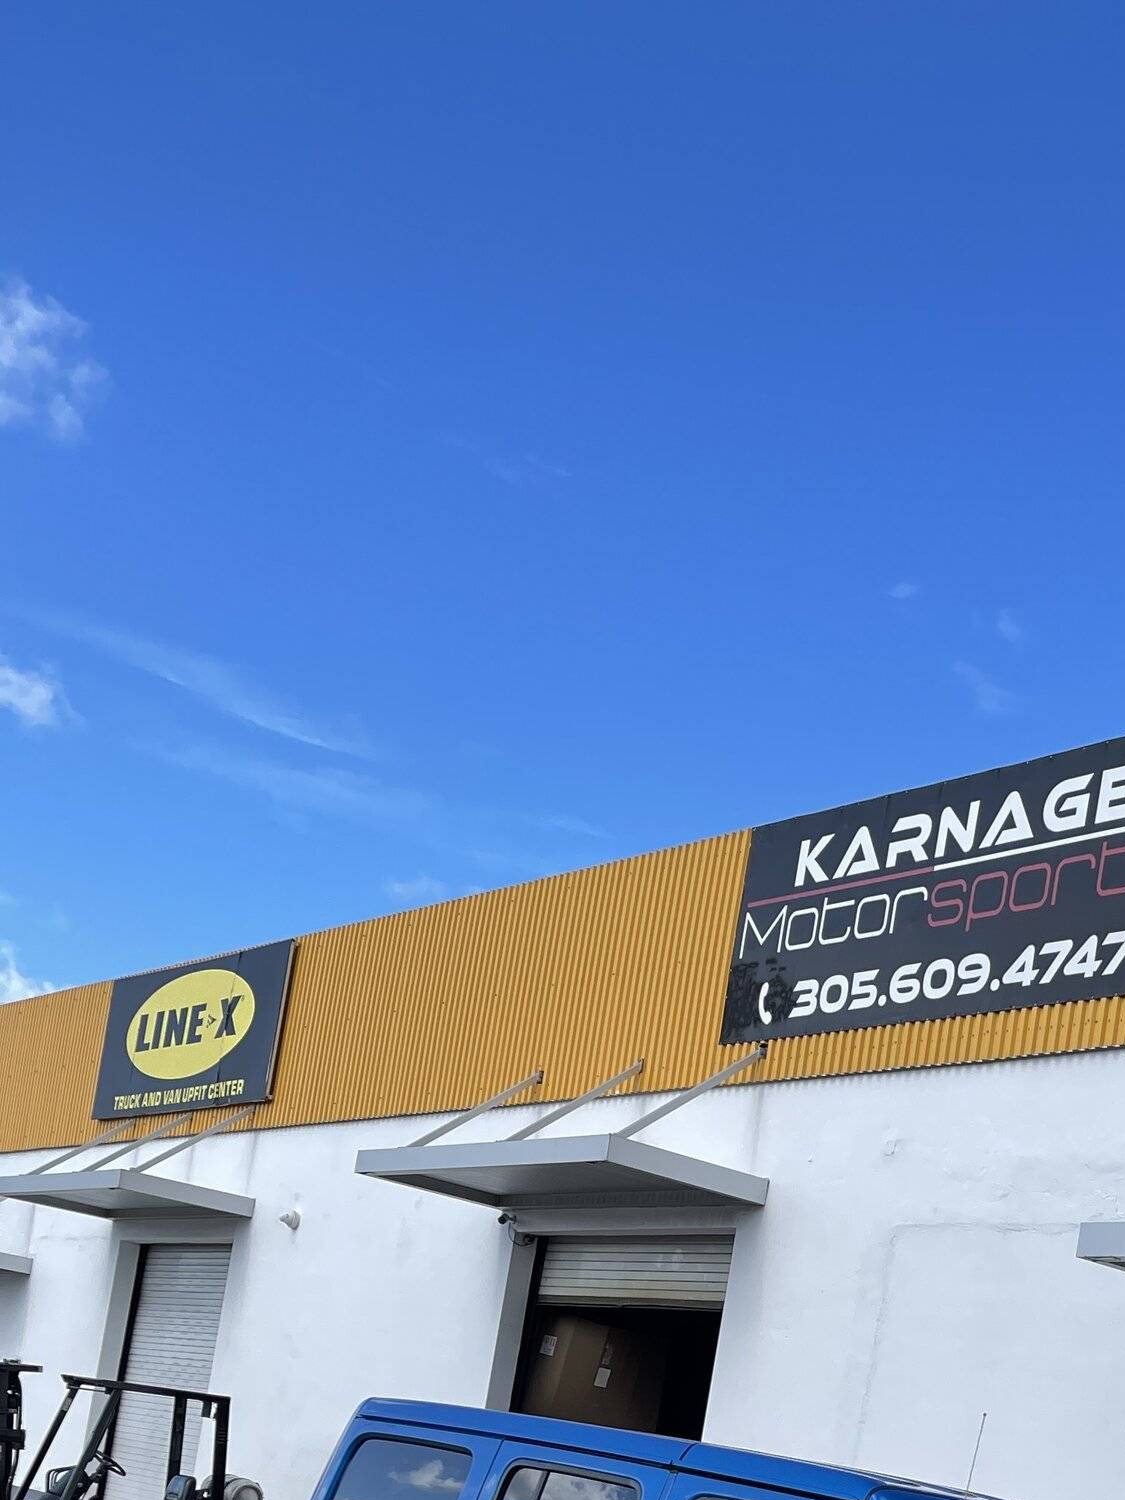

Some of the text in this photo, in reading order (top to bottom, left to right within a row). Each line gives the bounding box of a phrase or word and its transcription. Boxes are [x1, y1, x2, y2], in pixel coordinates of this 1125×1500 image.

[114, 1079, 245, 1111] TRUCK AND VAN UPFIT CENTER
